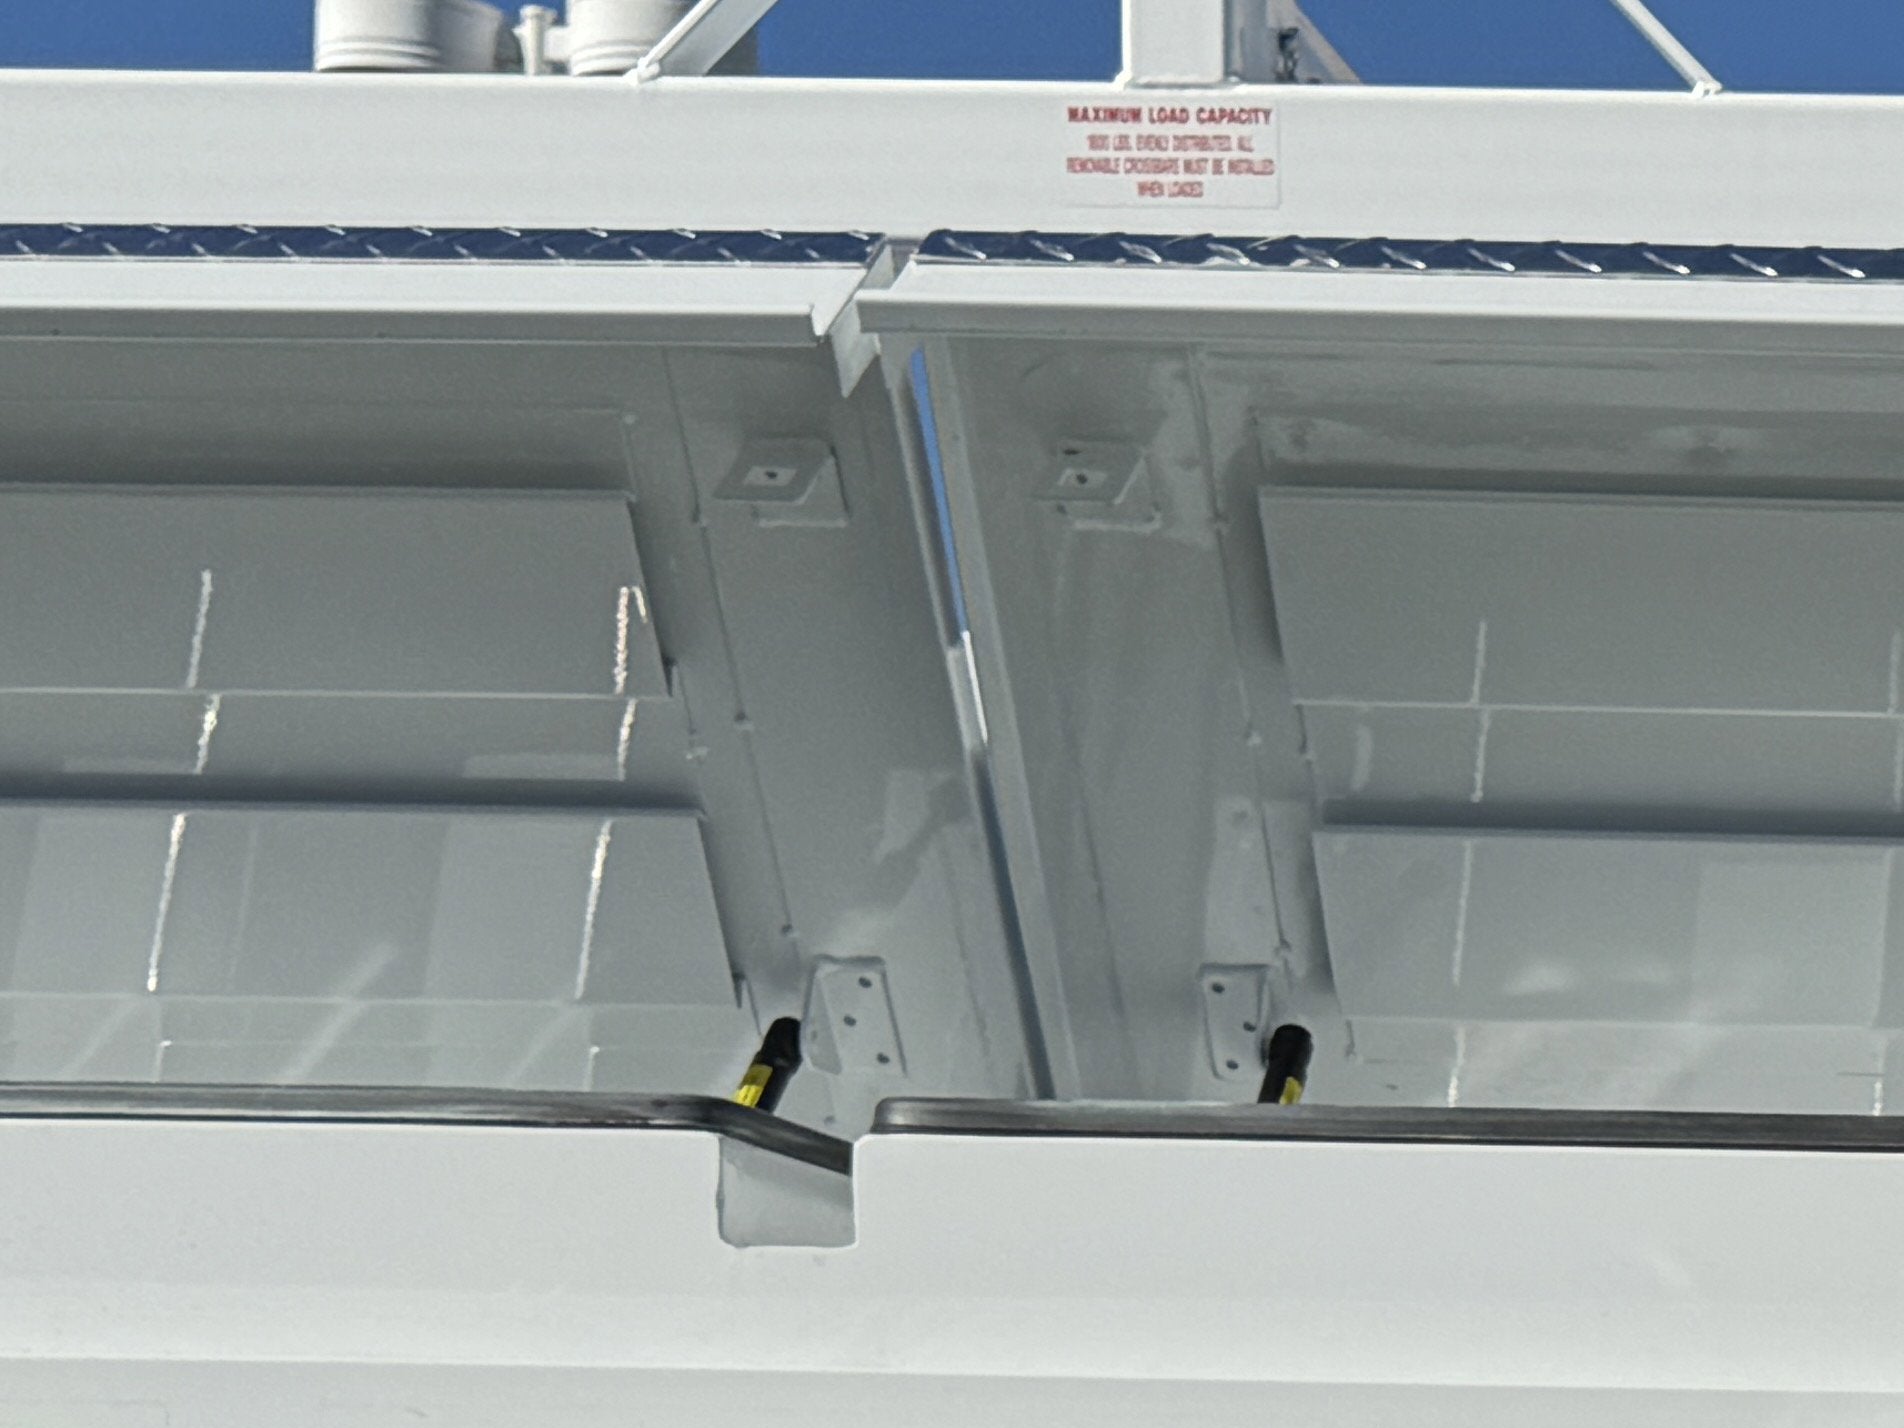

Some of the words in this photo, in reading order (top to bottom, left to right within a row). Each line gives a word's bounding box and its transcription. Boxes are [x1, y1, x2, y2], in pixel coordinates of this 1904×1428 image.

[1067, 106, 1142, 123] MAXIMUM
[1149, 107, 1189, 124] LOAD
[1196, 107, 1272, 124] CAPACITY
